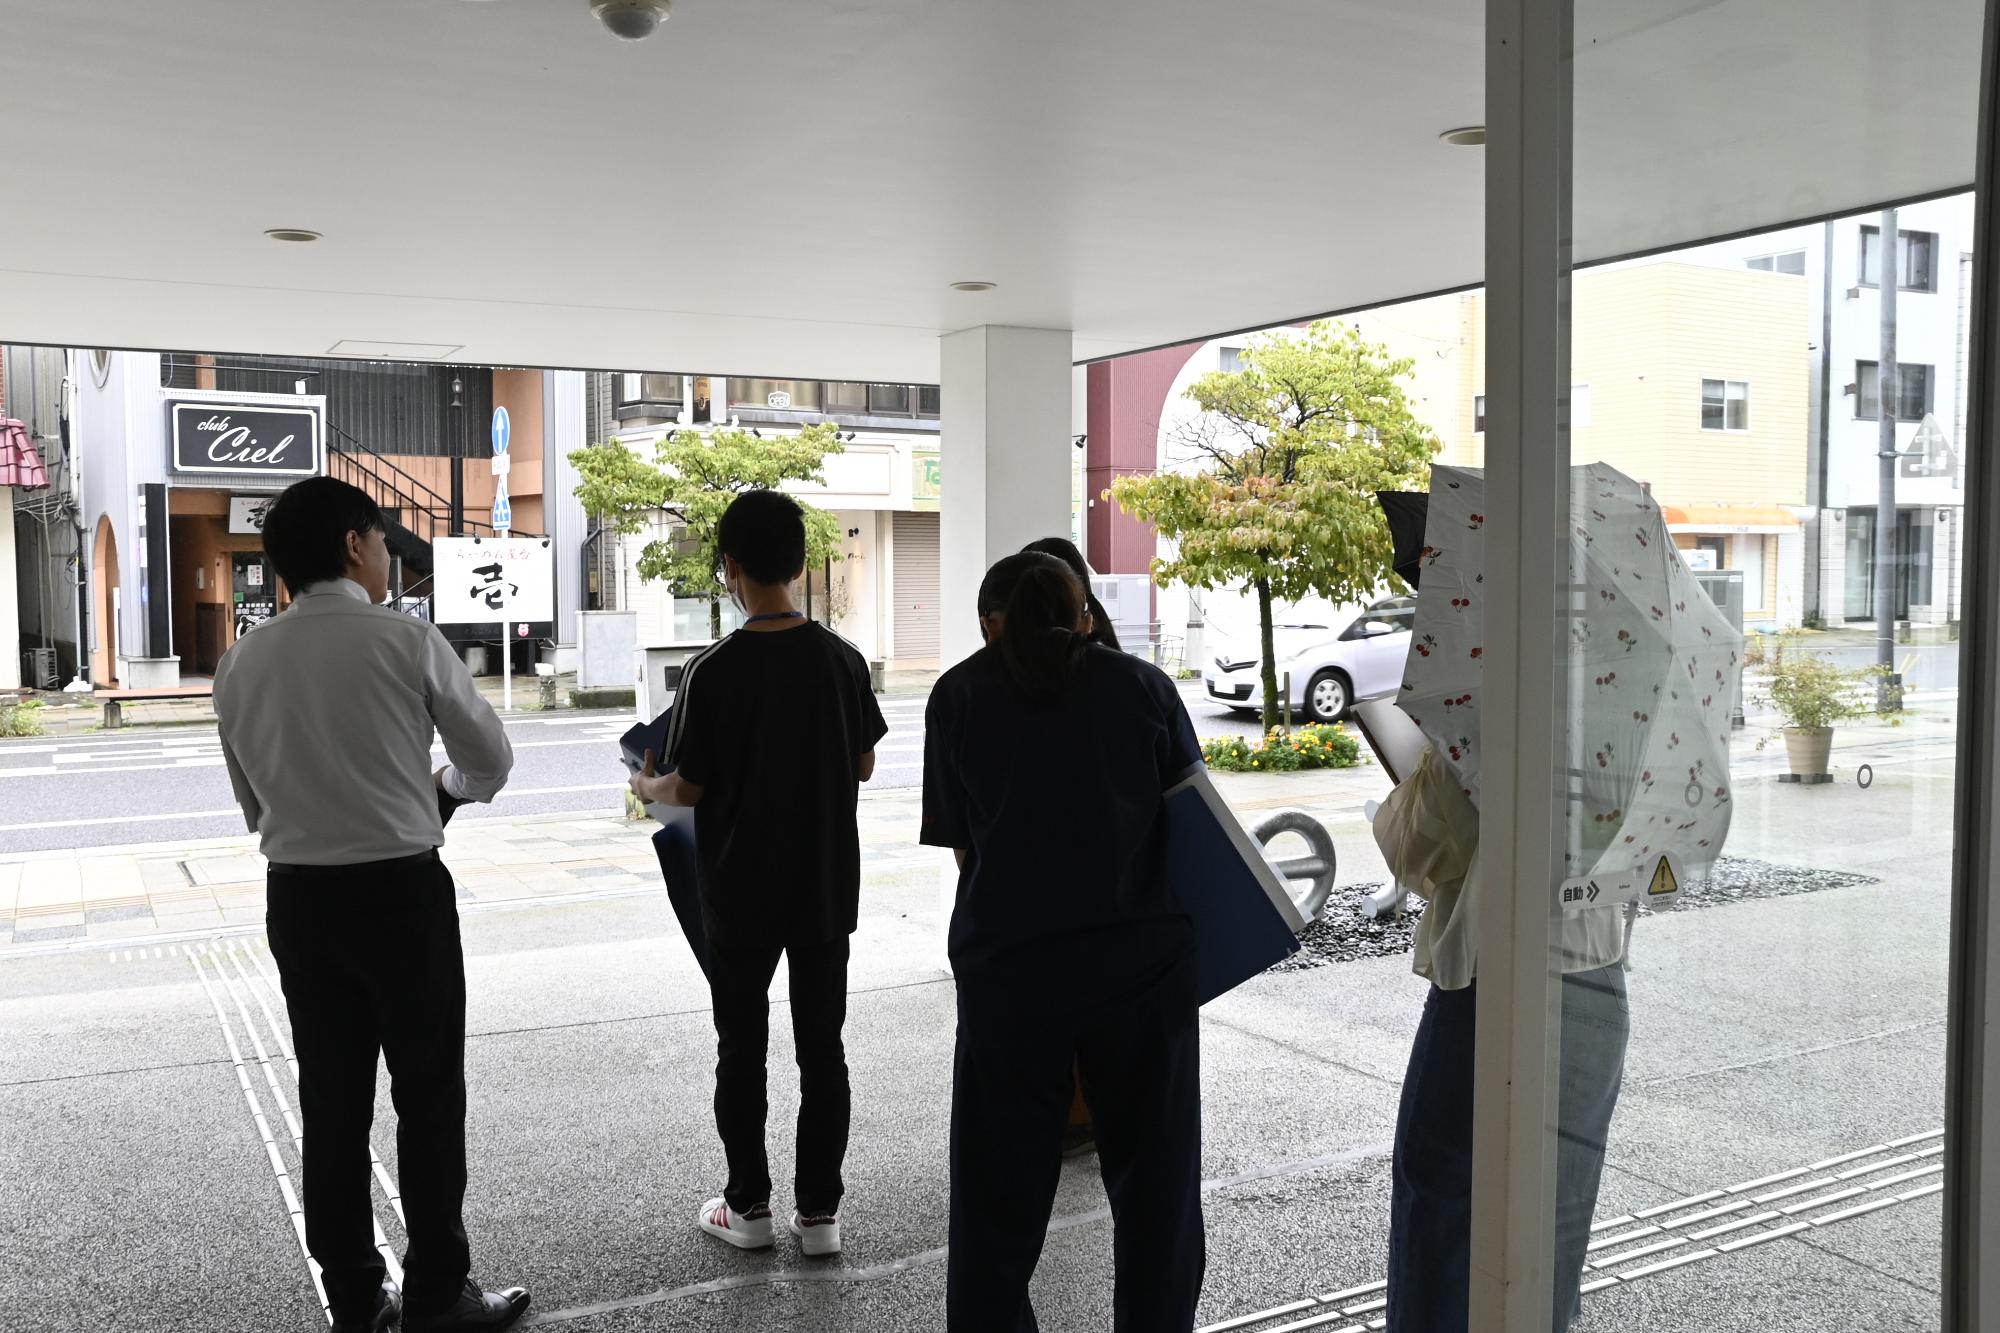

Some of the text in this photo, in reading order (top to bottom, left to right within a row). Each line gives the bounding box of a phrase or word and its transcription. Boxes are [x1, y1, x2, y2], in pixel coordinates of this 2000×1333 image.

[197, 415, 231, 432] club
[207, 426, 294, 464] Ciel
[1563, 886, 1584, 902] 自動
